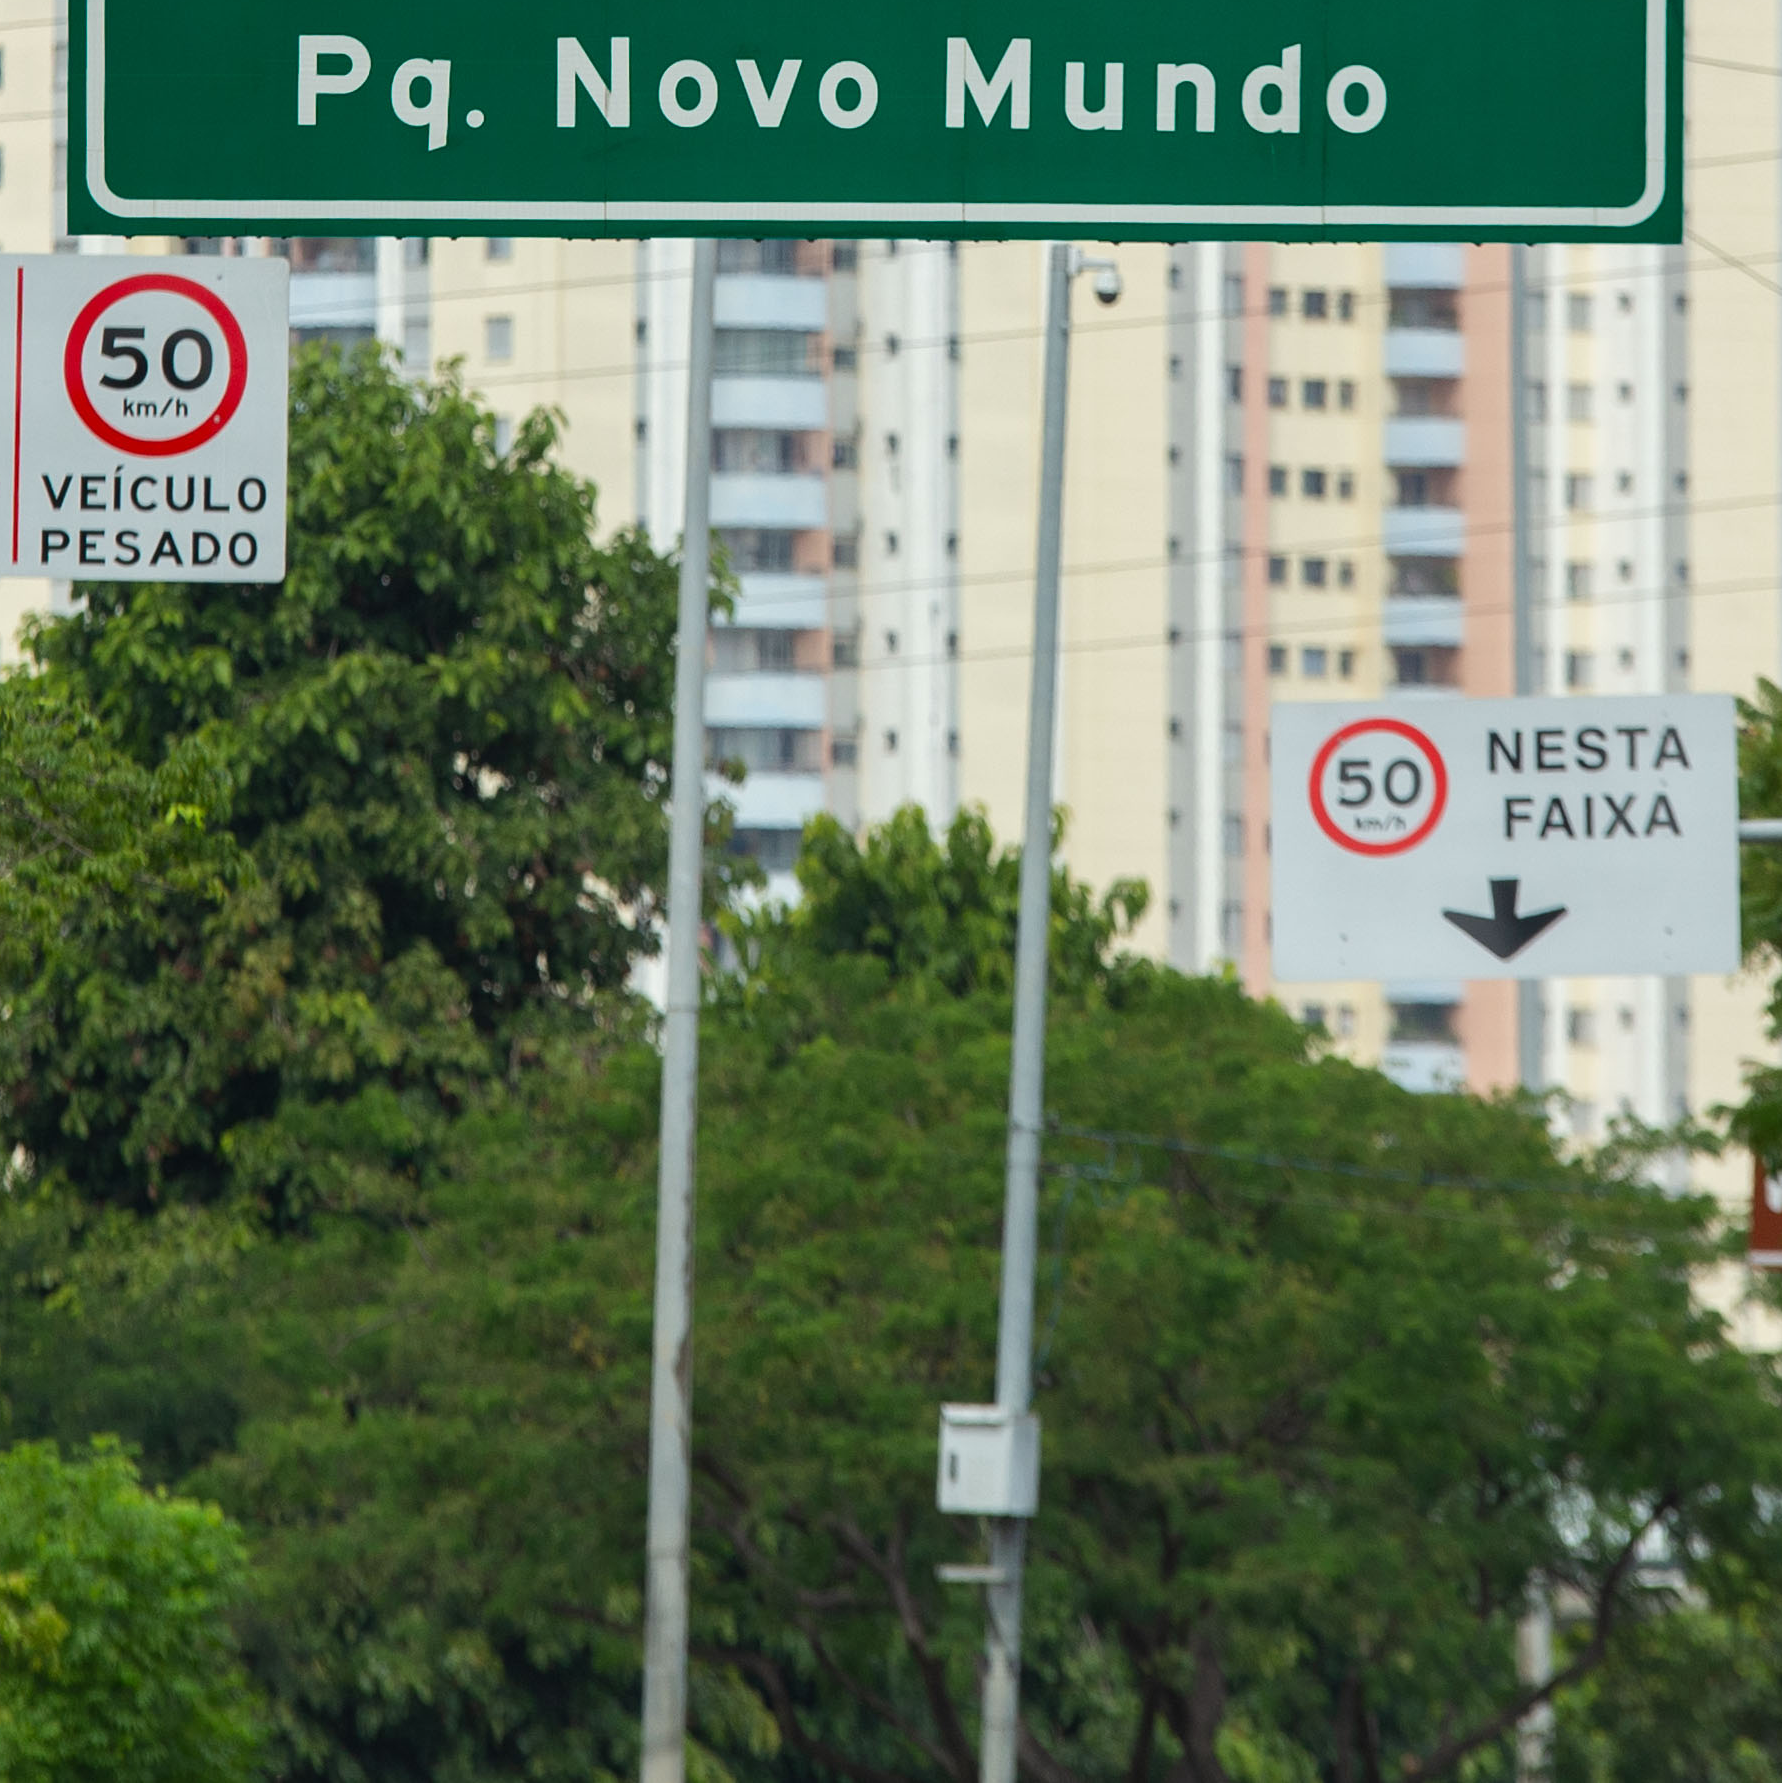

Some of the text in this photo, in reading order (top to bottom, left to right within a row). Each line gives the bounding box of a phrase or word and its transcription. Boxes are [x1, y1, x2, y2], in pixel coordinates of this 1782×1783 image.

[297, 34, 1387, 151] Pq. Novo Mundo
[98, 325, 214, 392] 50
[122, 396, 189, 418] km/h
[41, 464, 267, 514] VEÍCULO
[41, 528, 259, 568] PESADO
[1487, 726, 1690, 774] NESTA
[1337, 758, 1423, 808] 50
[1503, 793, 1681, 840] FAIXA
